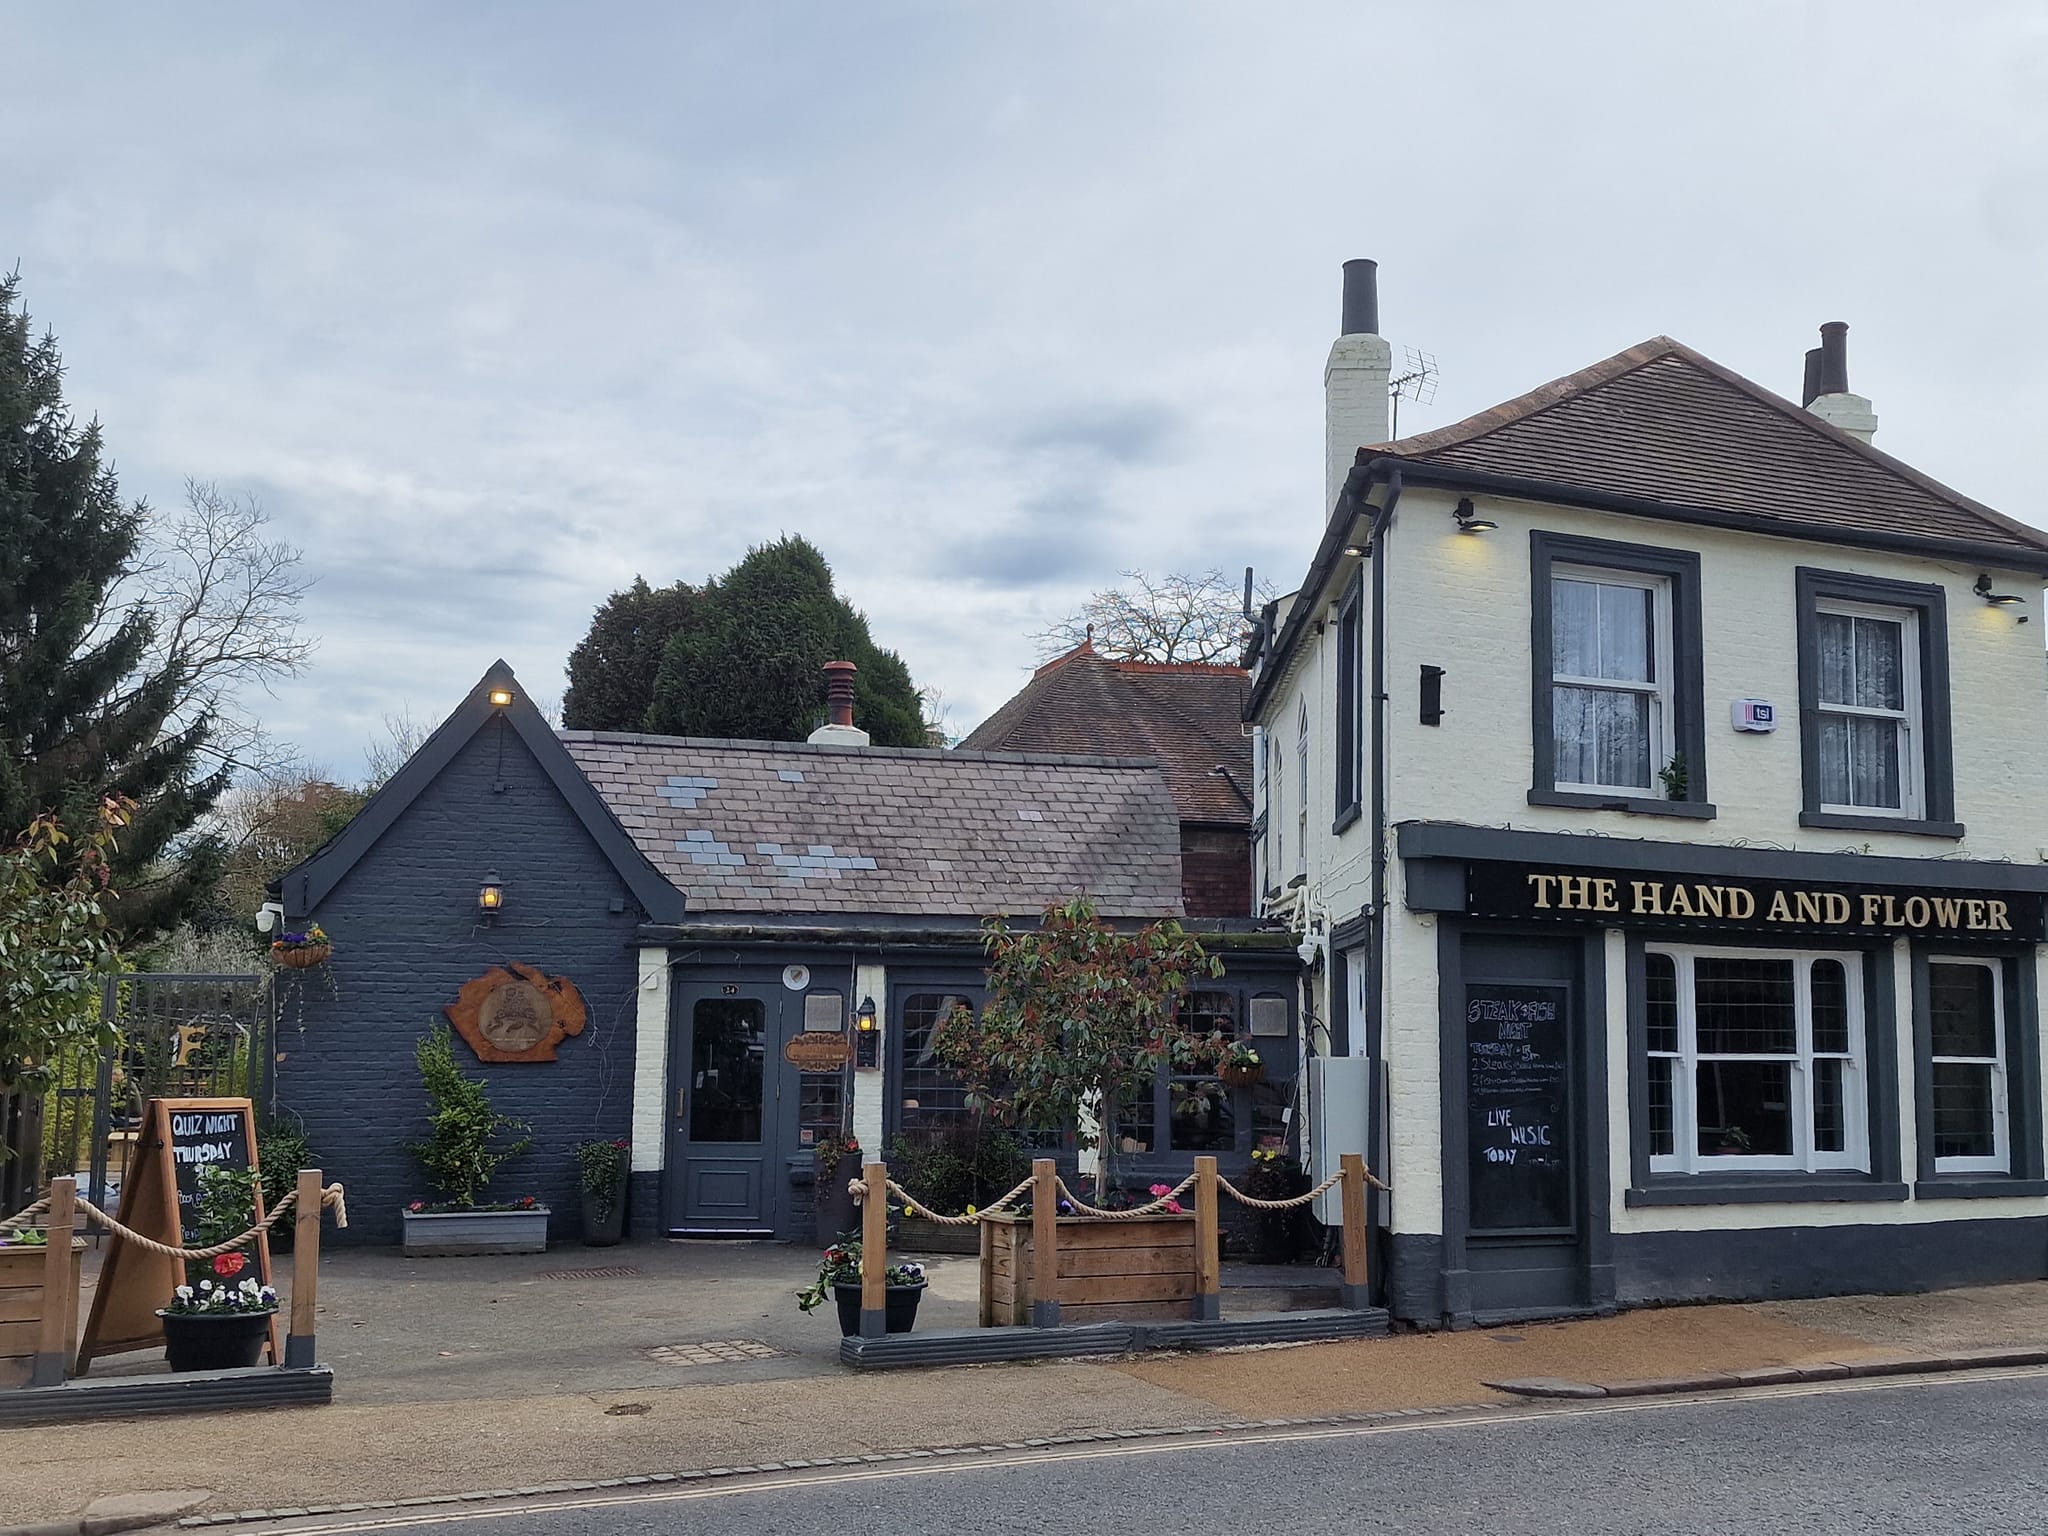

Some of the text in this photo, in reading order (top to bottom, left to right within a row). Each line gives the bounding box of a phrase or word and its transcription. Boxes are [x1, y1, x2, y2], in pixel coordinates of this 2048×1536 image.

[1528, 874, 2013, 931] THE HAND AND FLOWER
[173, 1114, 238, 1136] QUIZ NIGHT
[1488, 1107, 1513, 1127] LIVE
[1511, 1125, 1551, 1146] MUSIC
[173, 1141, 232, 1163] THURSDAY
[1483, 1147, 1517, 1166] TODAY
